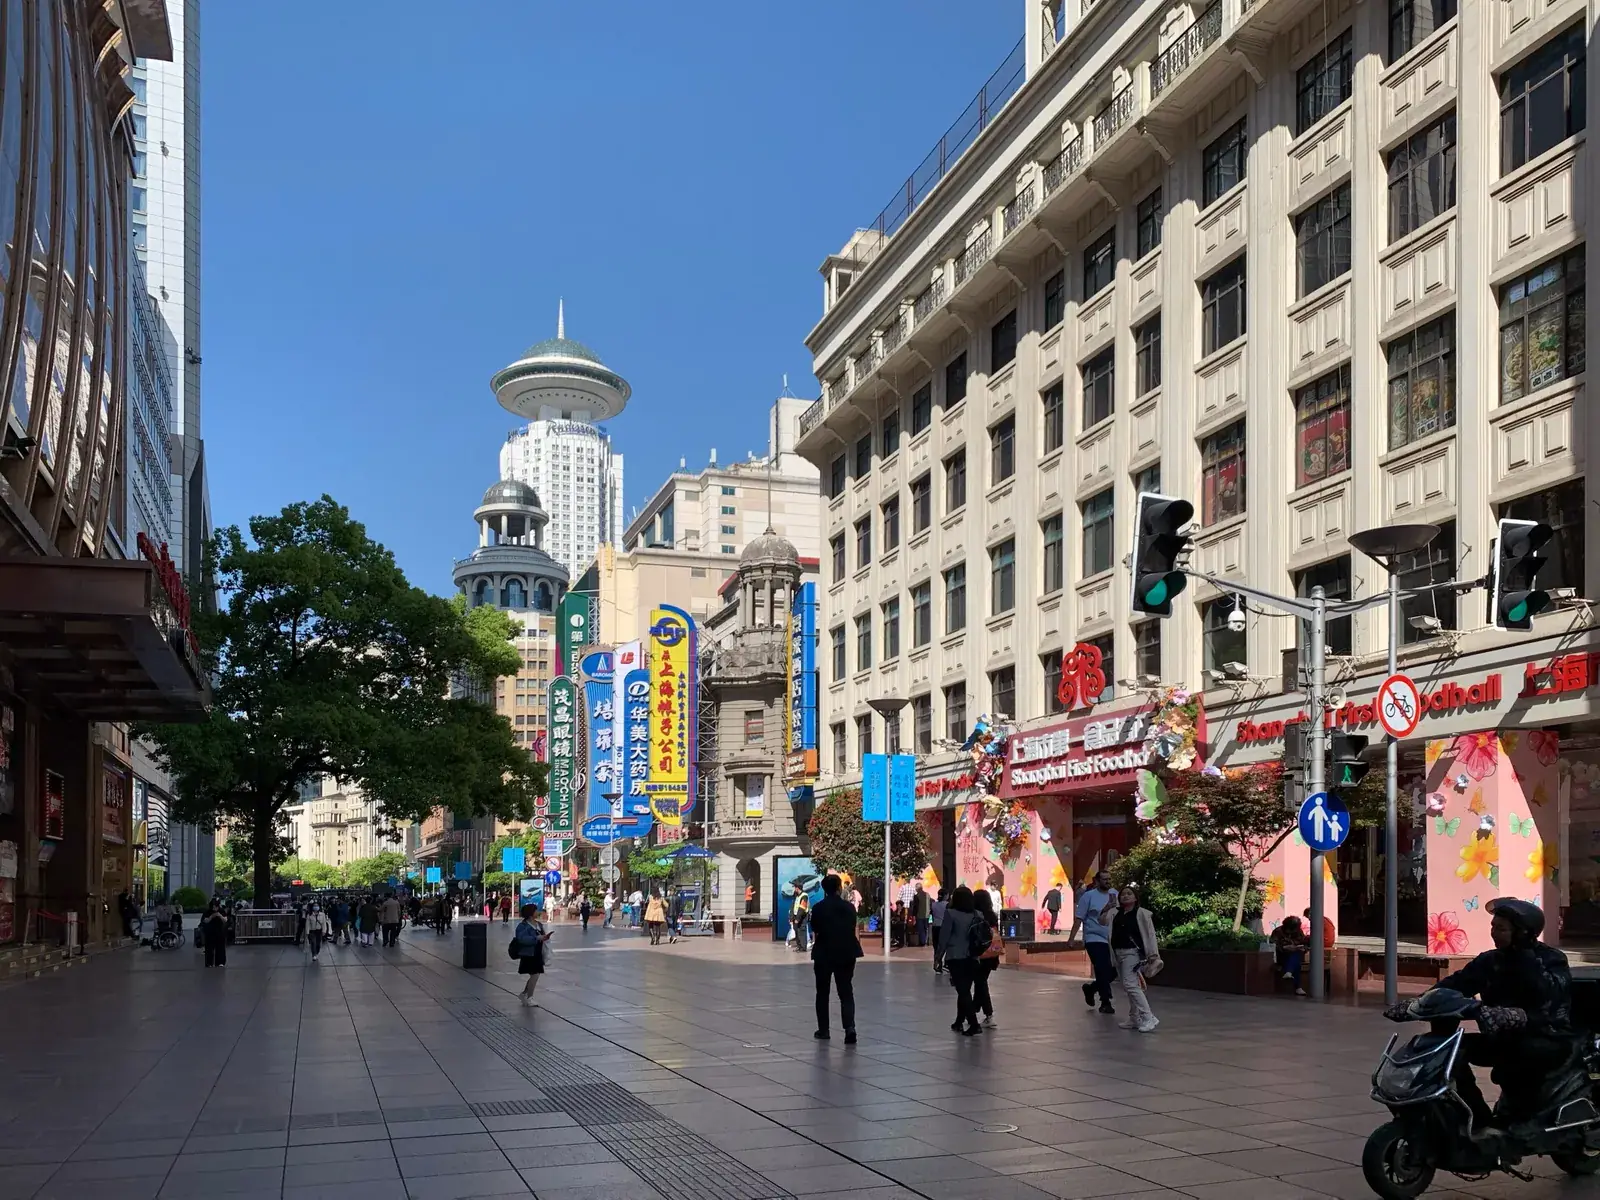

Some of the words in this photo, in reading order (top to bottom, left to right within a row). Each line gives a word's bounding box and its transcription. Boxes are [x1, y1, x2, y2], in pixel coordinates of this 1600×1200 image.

[546, 418, 598, 438] Radisson
[551, 688, 573, 758] 茂昌眼镜
[1237, 710, 1333, 742] Shani
[630, 706, 648, 796] 华美大药房
[1011, 762, 1067, 786] Shanghai
[1067, 756, 1094, 777] First
[1094, 748, 1150, 773] Foodha
[559, 759, 569, 827] MAOCHANG
